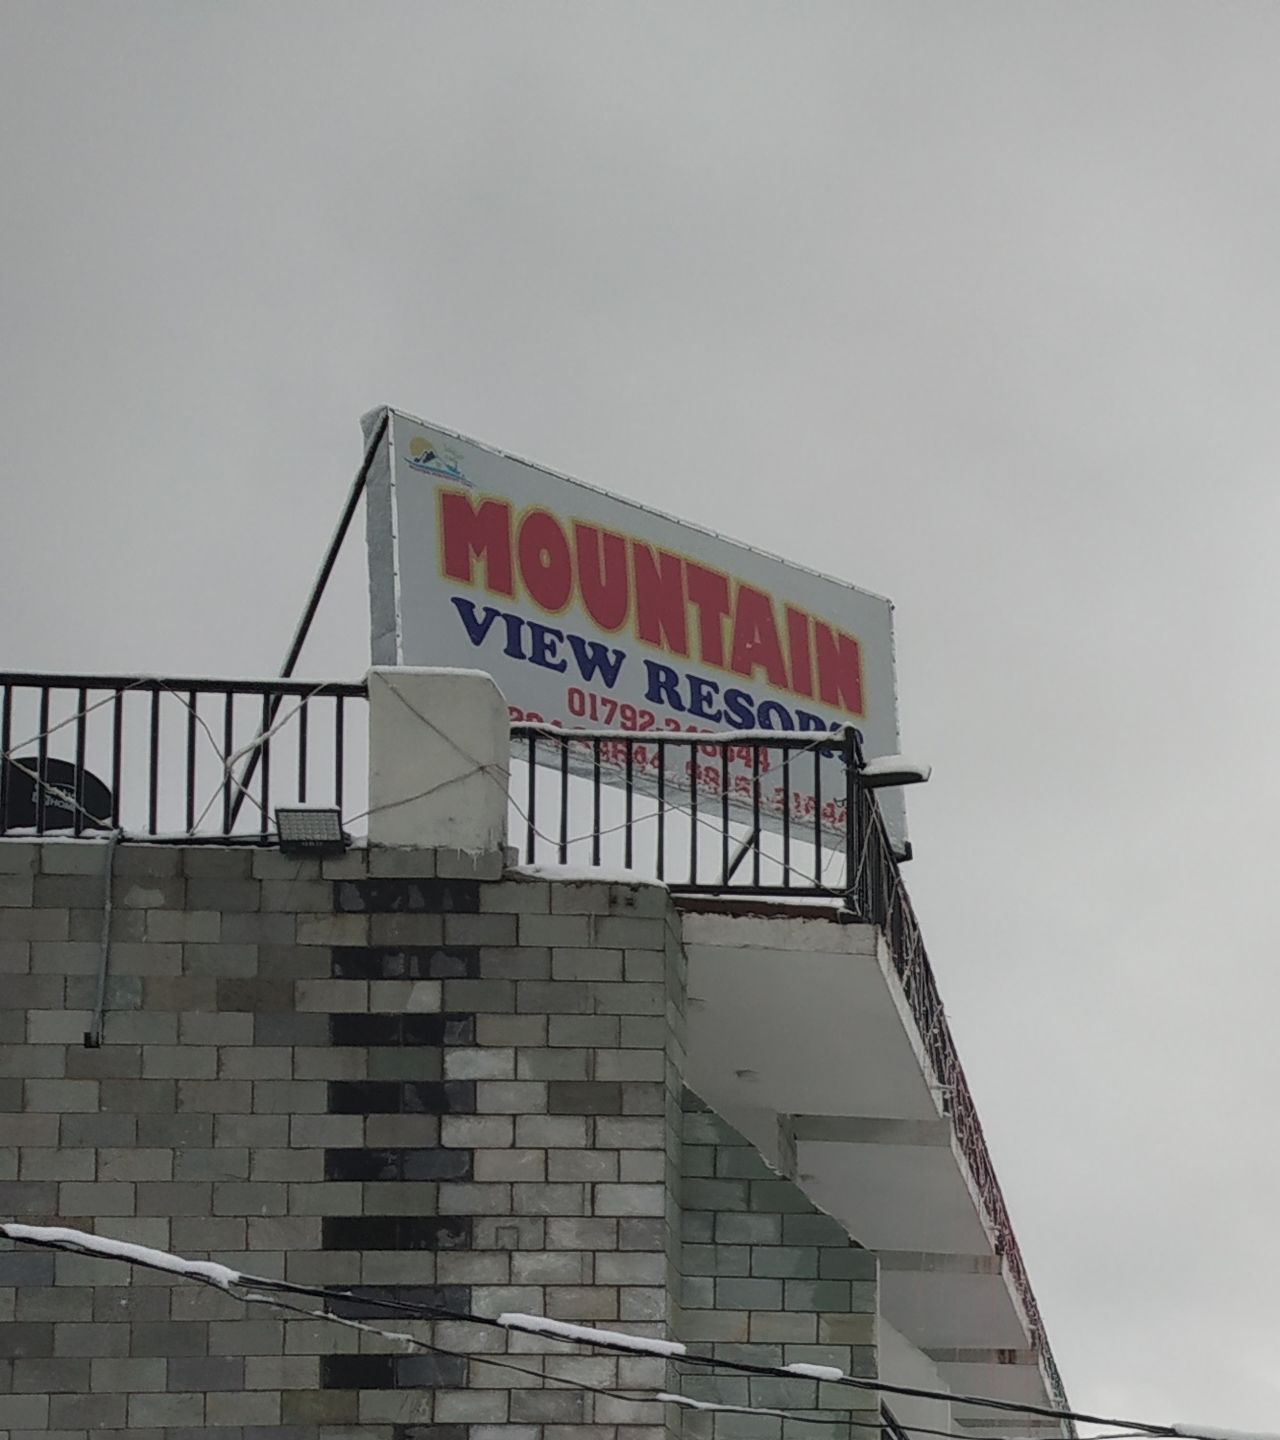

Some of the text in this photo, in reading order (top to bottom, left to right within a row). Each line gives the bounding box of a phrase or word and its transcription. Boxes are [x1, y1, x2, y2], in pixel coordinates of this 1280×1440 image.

[438, 488, 865, 716] MOUNTAIN
[450, 596, 626, 689] VIEW
[643, 658, 863, 776] RESOR
